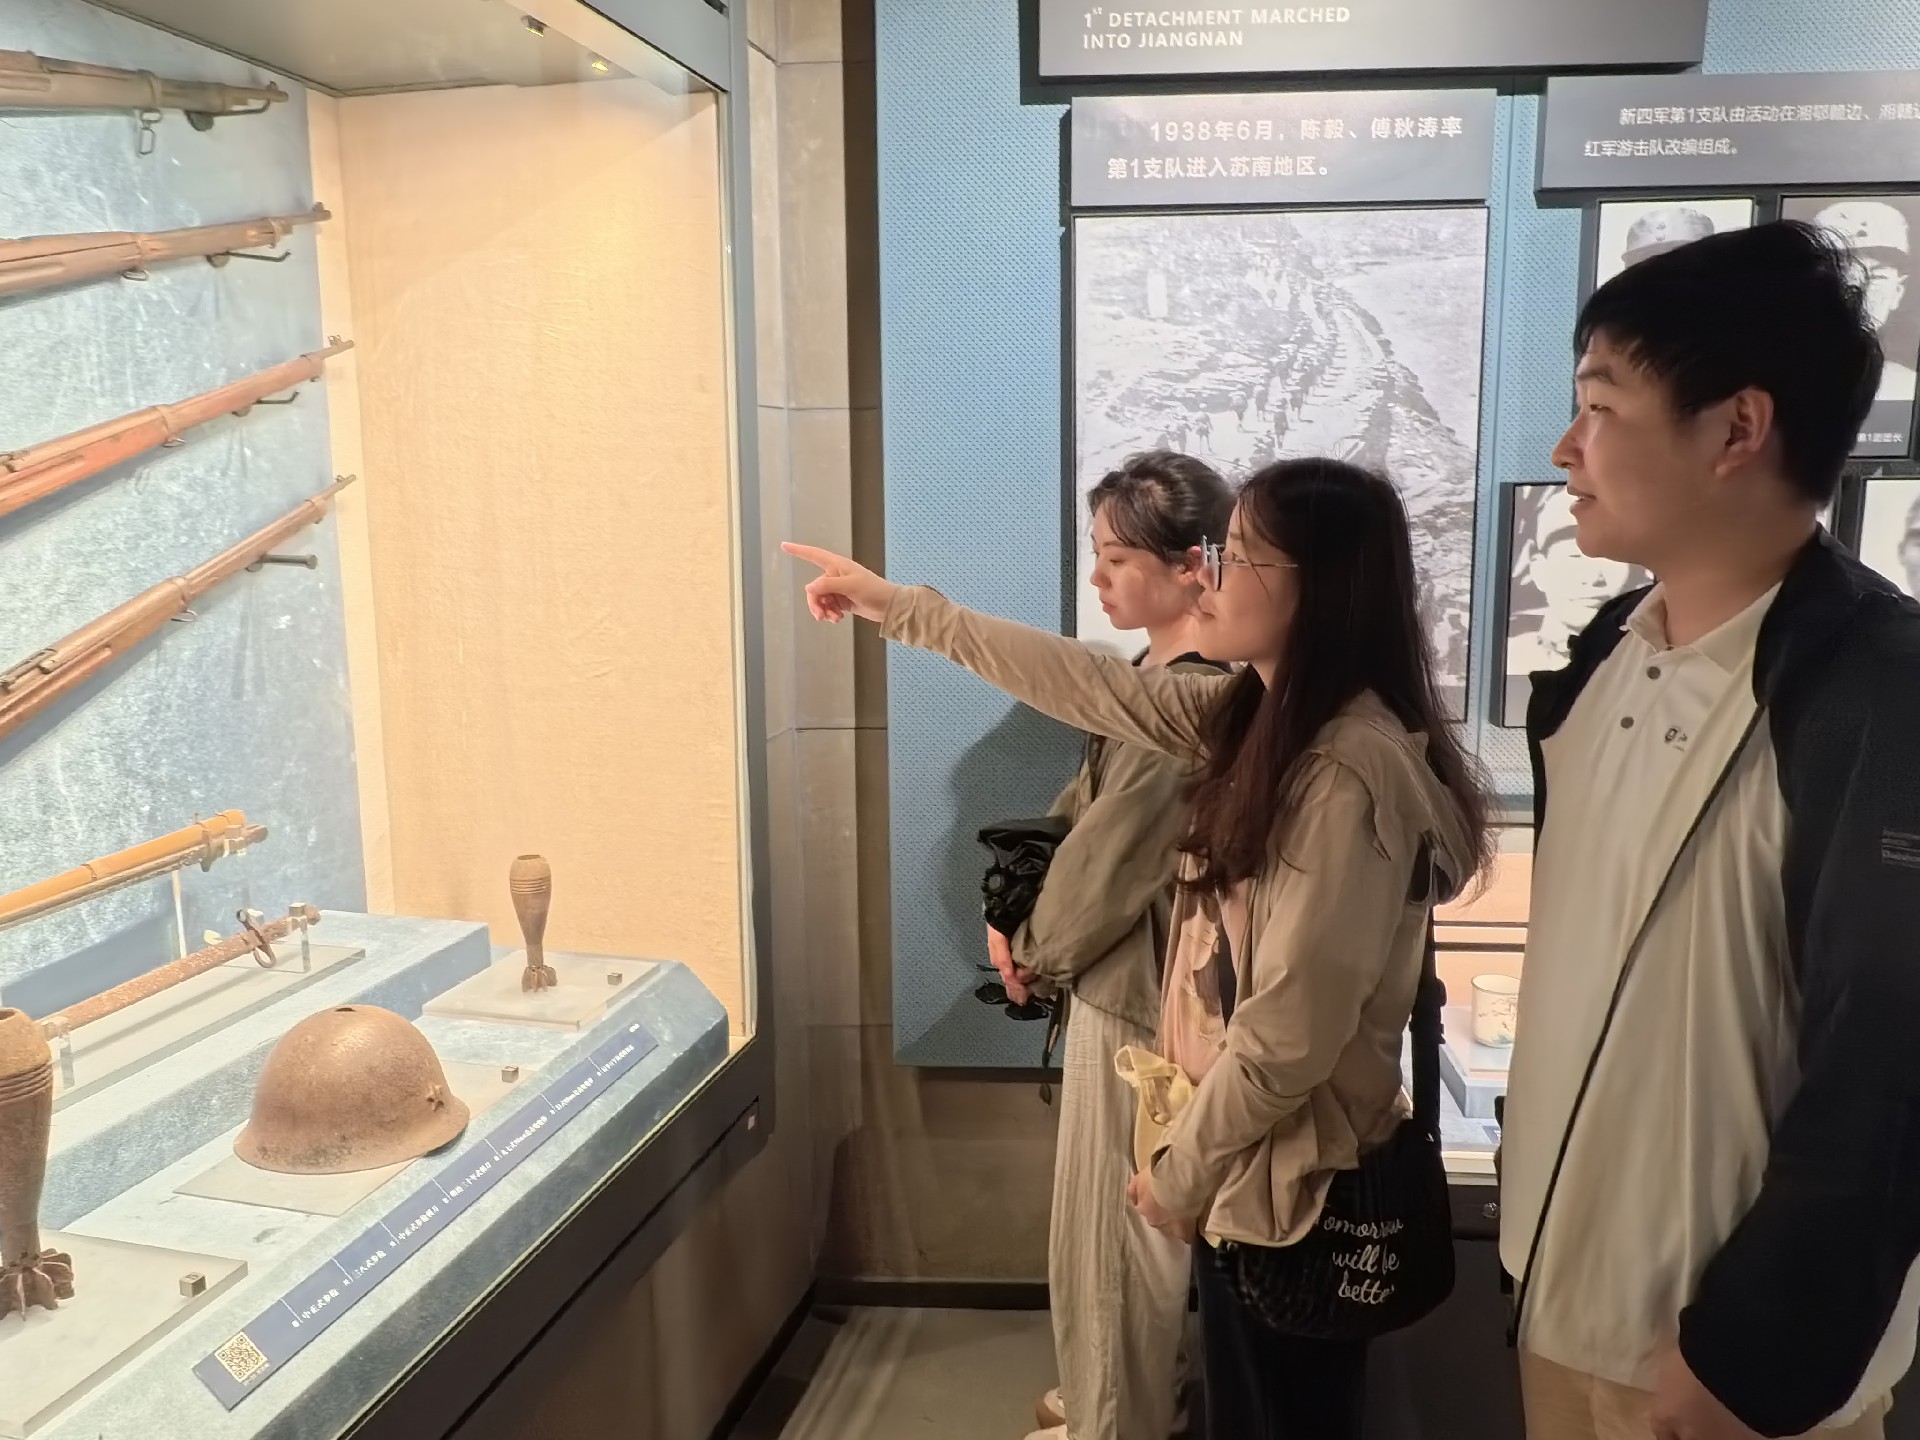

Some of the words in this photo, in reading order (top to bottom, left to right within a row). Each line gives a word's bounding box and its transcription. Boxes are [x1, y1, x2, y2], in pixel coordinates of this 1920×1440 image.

[1108, 9, 1244, 28] DETACHMENT
[1250, 6, 1351, 25] MARCHED
[1083, 33, 1132, 50] INTO
[1137, 30, 1244, 48] JIANGNAN
[1107, 155, 1329, 179] 第1支队进入苏南地区。
[1332, 1244, 1380, 1273] will
